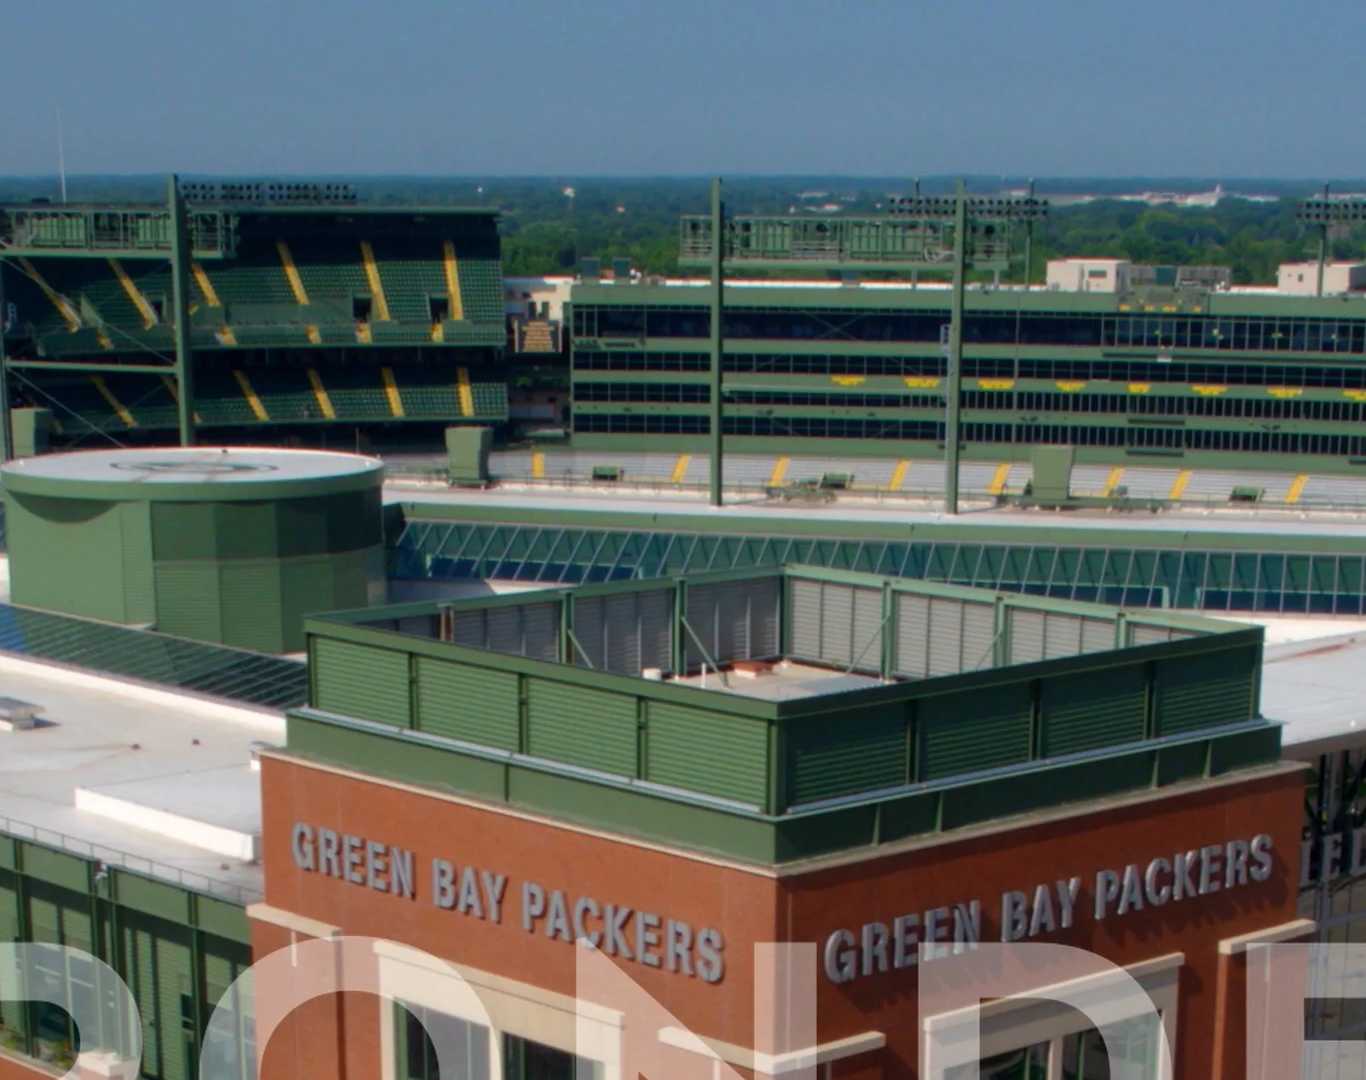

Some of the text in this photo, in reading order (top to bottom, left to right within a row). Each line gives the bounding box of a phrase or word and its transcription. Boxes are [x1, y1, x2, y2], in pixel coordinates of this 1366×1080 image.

[291, 822, 724, 983] GREEN BAY PACKERS
[824, 834, 1273, 984] GREEN BAY PACKERS
